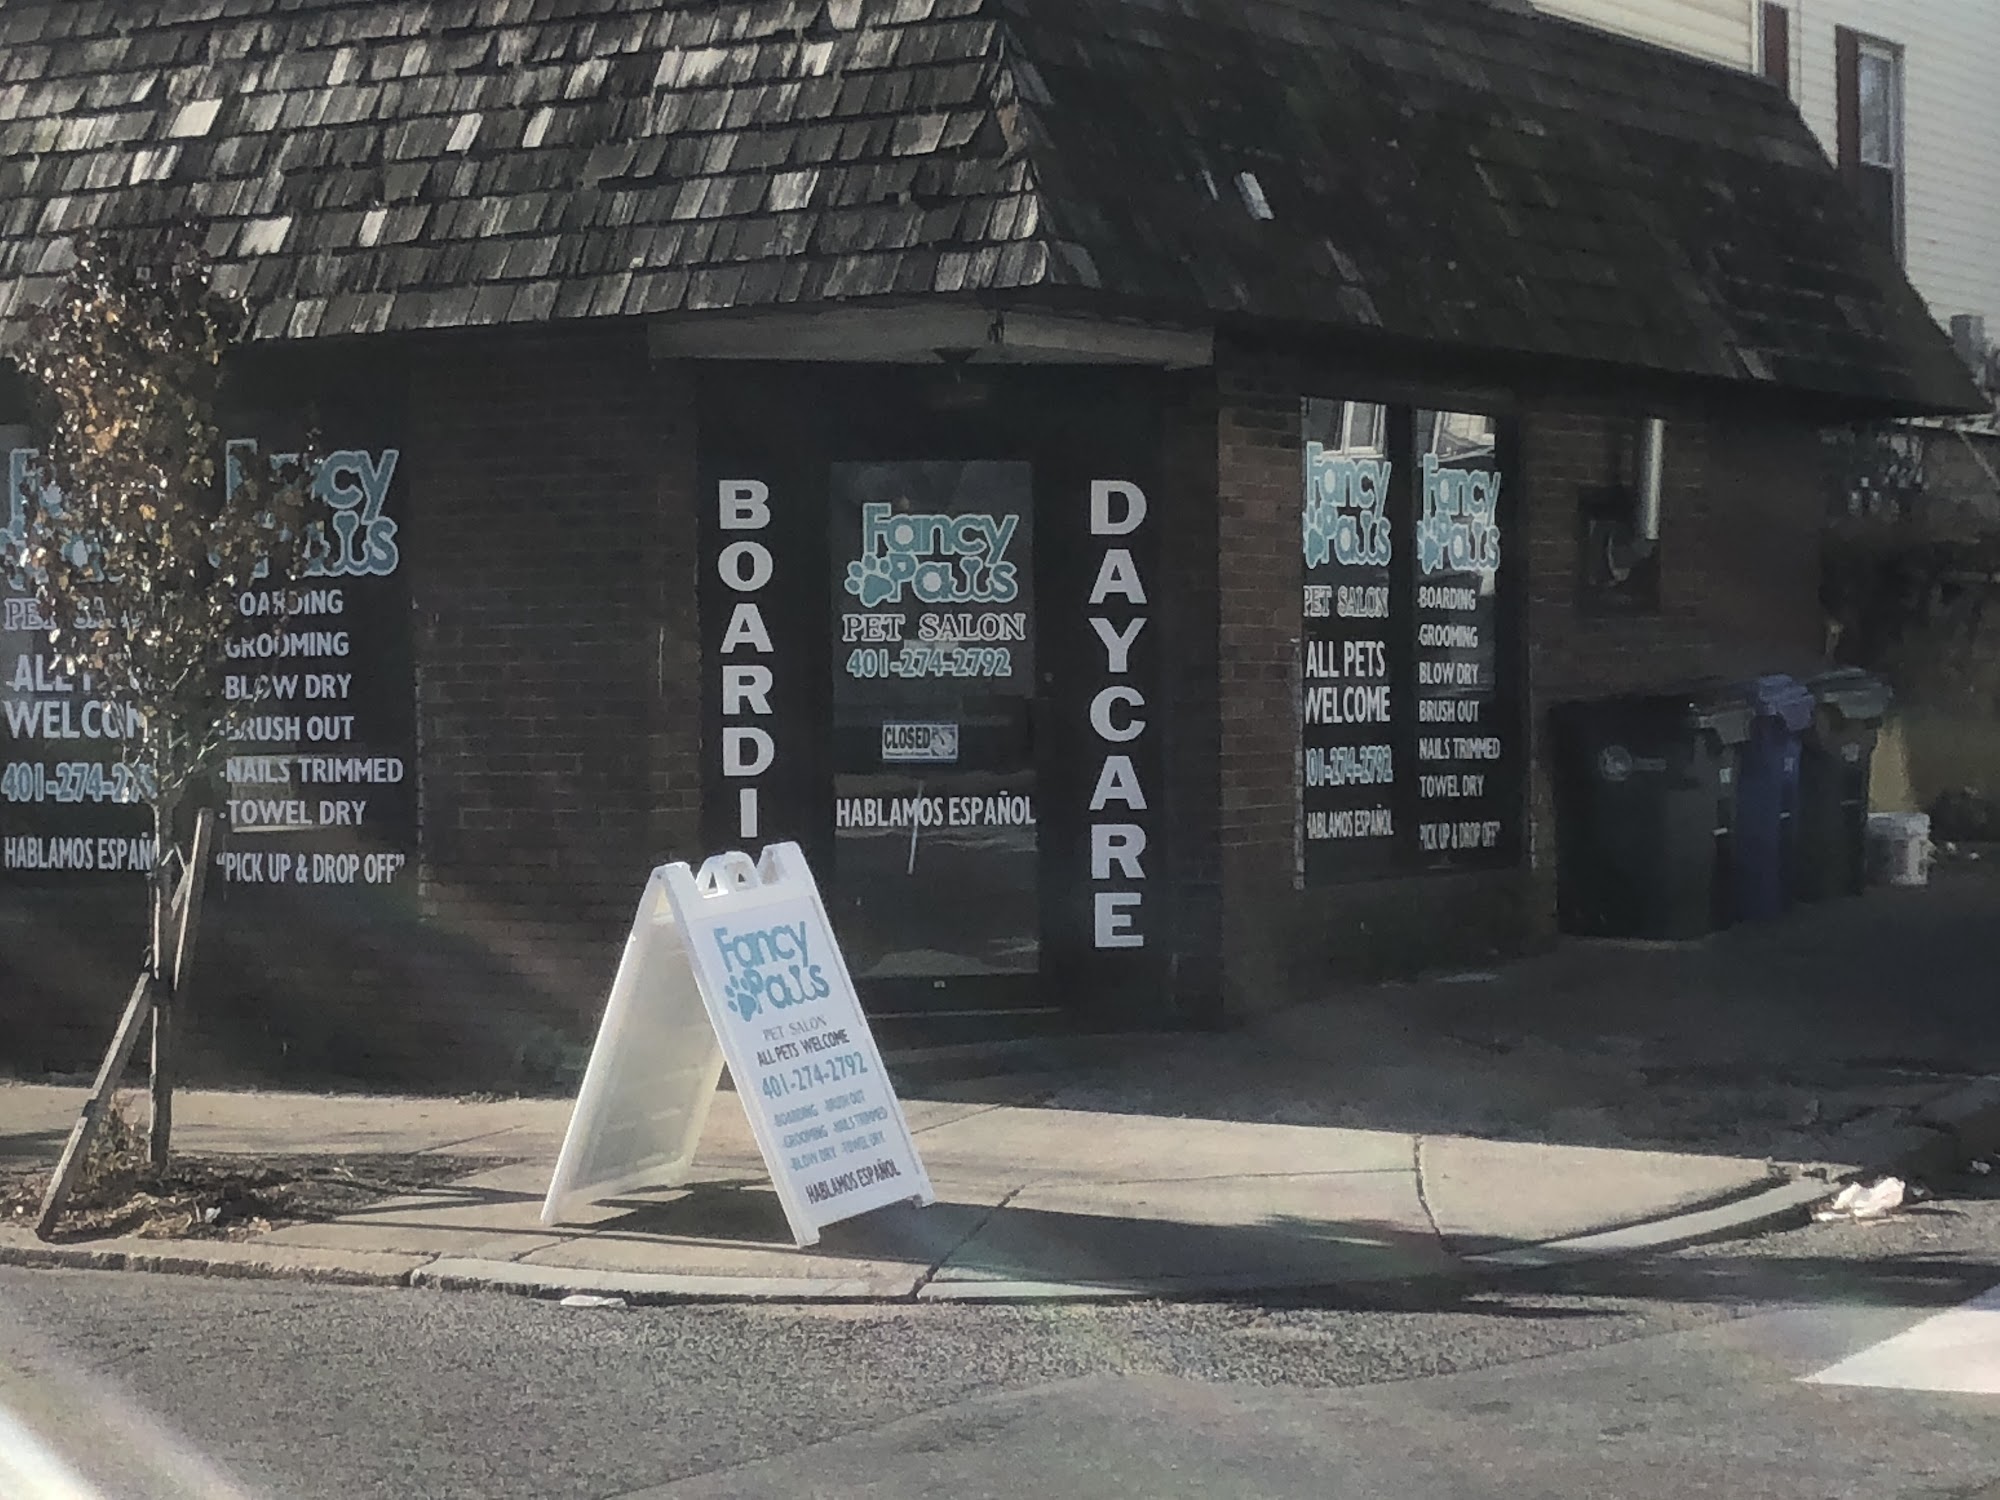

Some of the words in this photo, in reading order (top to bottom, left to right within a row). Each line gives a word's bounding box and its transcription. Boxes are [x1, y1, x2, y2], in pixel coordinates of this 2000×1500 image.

[1306, 441, 1392, 524] Fancy
[1423, 453, 1501, 527] Fancy
[863, 502, 1019, 567] Fancy
[237, 588, 344, 617] OARDING
[1303, 585, 1332, 617] PET
[1337, 585, 1389, 618] SALON
[1419, 586, 1476, 611] BOARDING
[842, 613, 906, 642] PET
[917, 612, 1027, 642] SALON
[1419, 623, 1479, 648] GROOMING
[224, 631, 350, 659] GROOMING
[718, 479, 775, 838] BOARDI
[1305, 641, 1340, 678] ALL
[1343, 641, 1386, 677] PETS
[846, 647, 1012, 678] 401-274-2792
[1419, 661, 1455, 685] BLOW
[1456, 663, 1479, 685] DRY
[224, 674, 299, 701] BLOW
[305, 673, 352, 699] DRY
[1088, 480, 1148, 947] DAYCARE
[1304, 685, 1391, 724] WELCOME
[1419, 700, 1456, 722] BRUSH
[1457, 700, 1479, 722] OUT
[306, 715, 355, 742] OUT
[884, 726, 931, 749] CLOSED
[1419, 737, 1450, 760] NAILS
[1452, 737, 1500, 760] TRIMMED
[226, 758, 291, 783] NAILS
[297, 757, 404, 783] TRIMMED
[1305, 744, 1394, 787] 01-274-2792
[1419, 774, 1460, 798] TOWEL
[1462, 774, 1485, 797] DRY
[226, 800, 313, 825] TOWEL
[319, 800, 366, 825] DRY
[836, 797, 944, 827] HABLAMOS
[948, 790, 1037, 826] ESPAÑOL
[1354, 803, 1394, 837] ESPAÑOL
[4, 837, 94, 870] HABLAMOS
[97, 832, 159, 871] ESPAÑ
[268, 853, 292, 883] UP
[295, 852, 309, 884] &
[312, 853, 360, 884] DROP
[713, 920, 808, 972] Fancy
[762, 1025, 784, 1040] PET
[788, 1015, 827, 1035] SALON
[756, 1049, 776, 1067] ALL
[774, 1042, 800, 1062] PETS
[800, 1028, 850, 1054] WELCOME
[762, 1051, 868, 1099] 401-274-2792
[805, 1171, 859, 1204] HABLAMOS
[855, 1158, 901, 1187] ESPAÑOL
